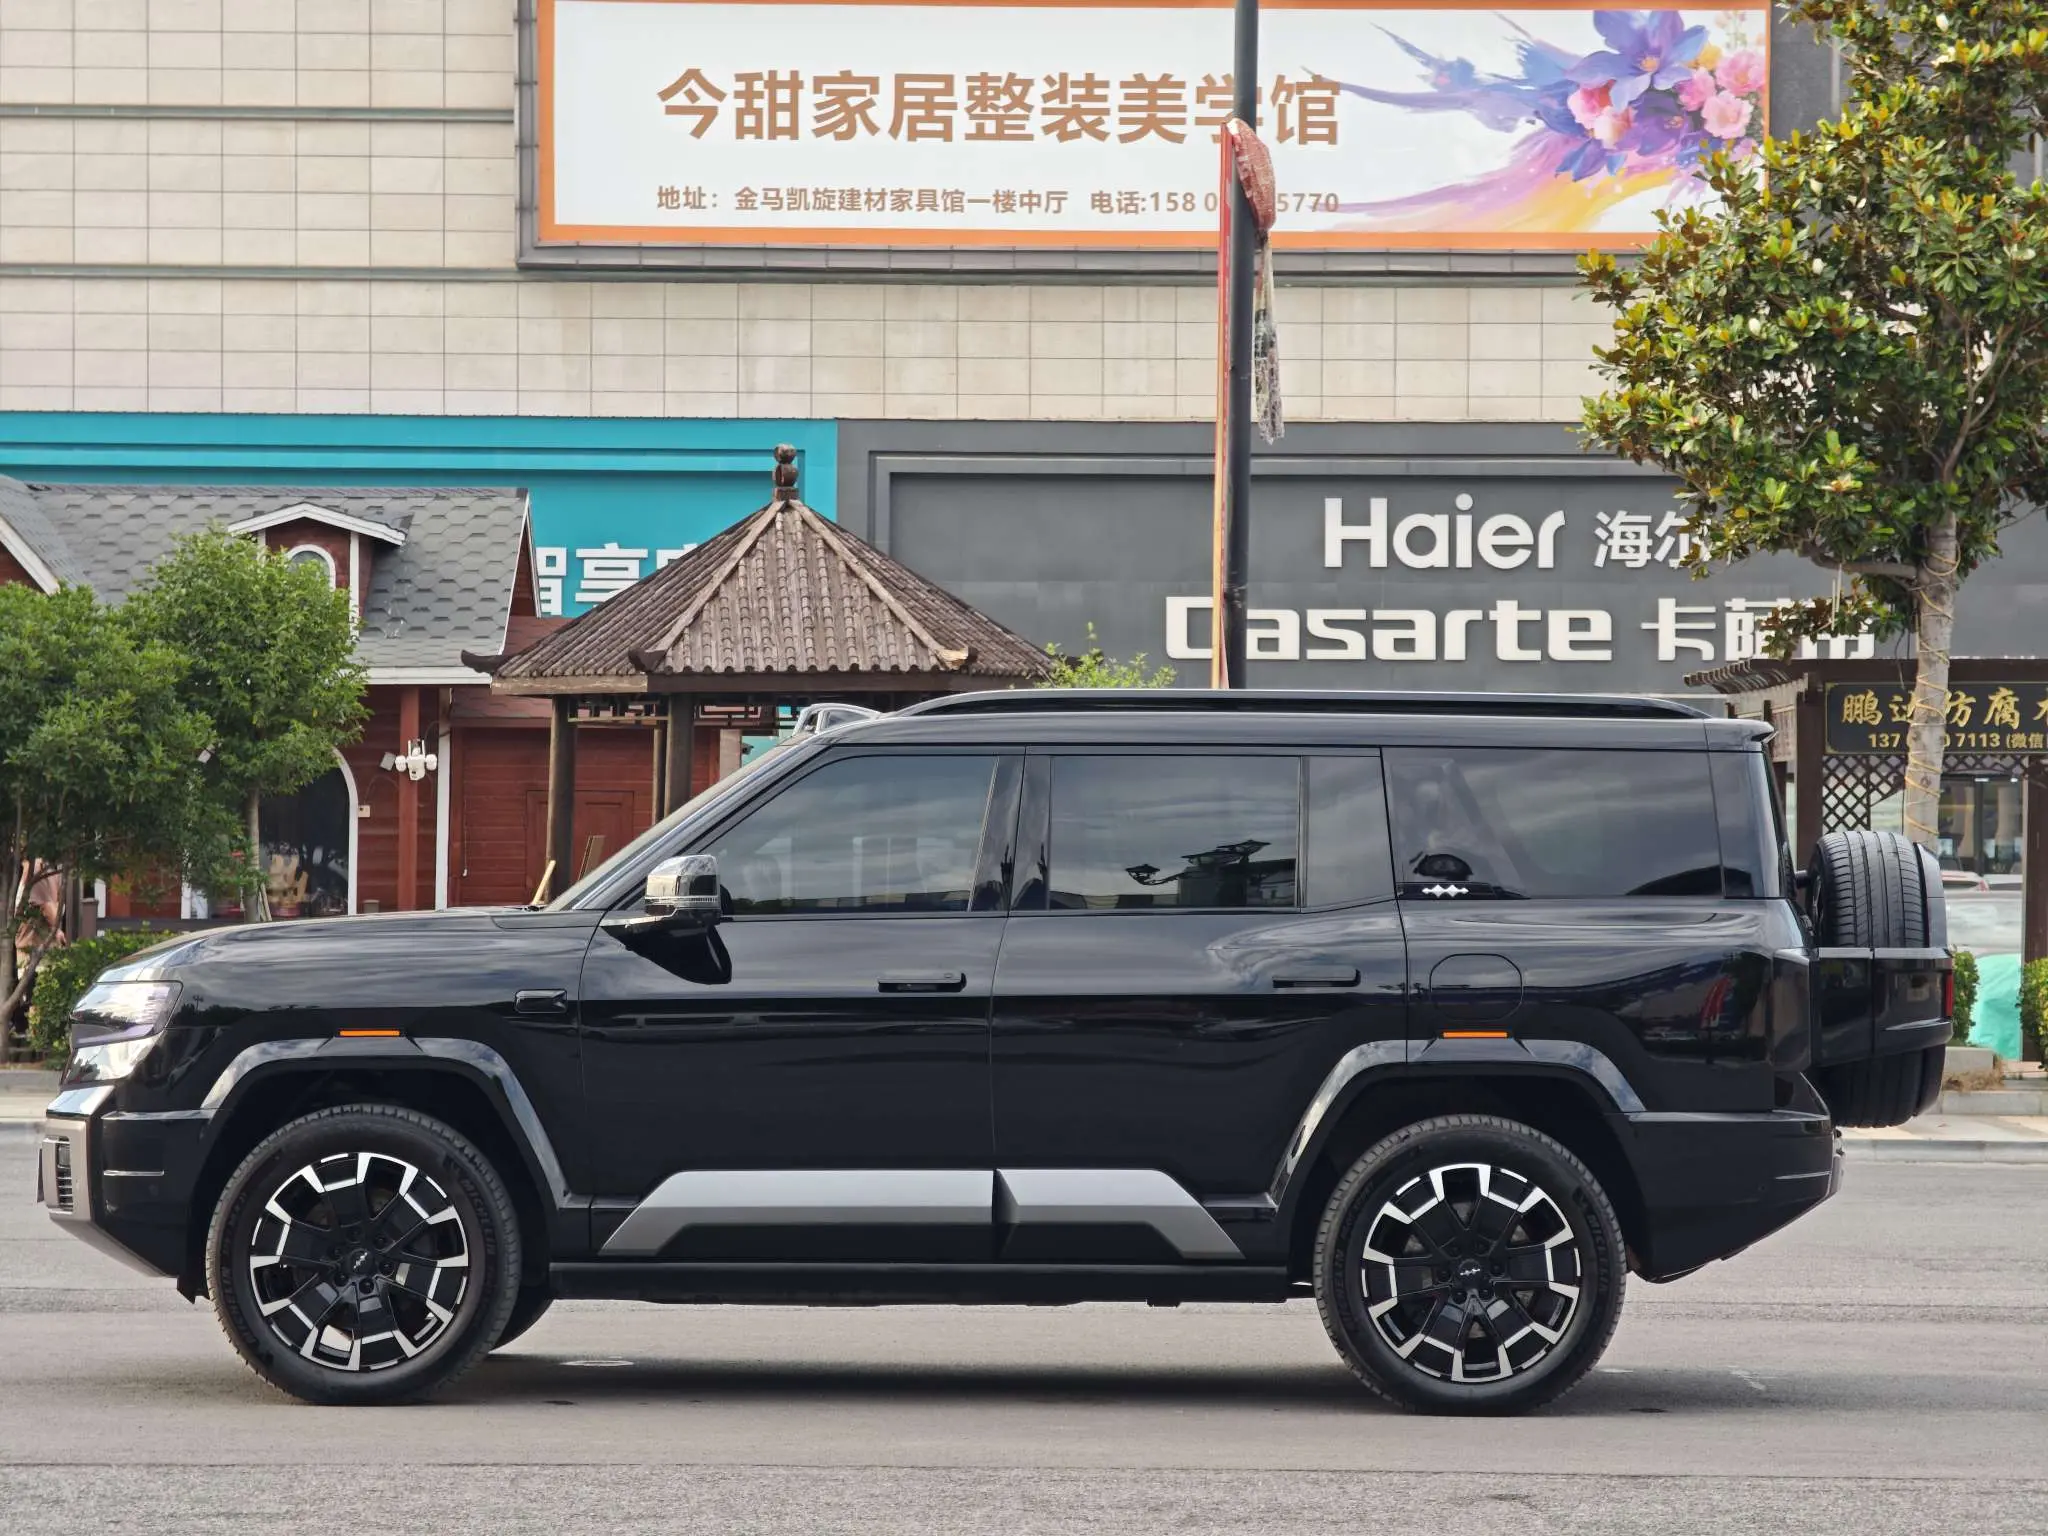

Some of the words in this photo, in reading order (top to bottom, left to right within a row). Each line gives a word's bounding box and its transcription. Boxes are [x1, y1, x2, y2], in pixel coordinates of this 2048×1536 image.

[657, 68, 1341, 145] 今甜家居整装美学馆
[1323, 492, 1566, 569] Haier
[1165, 596, 1613, 662] Casarte
